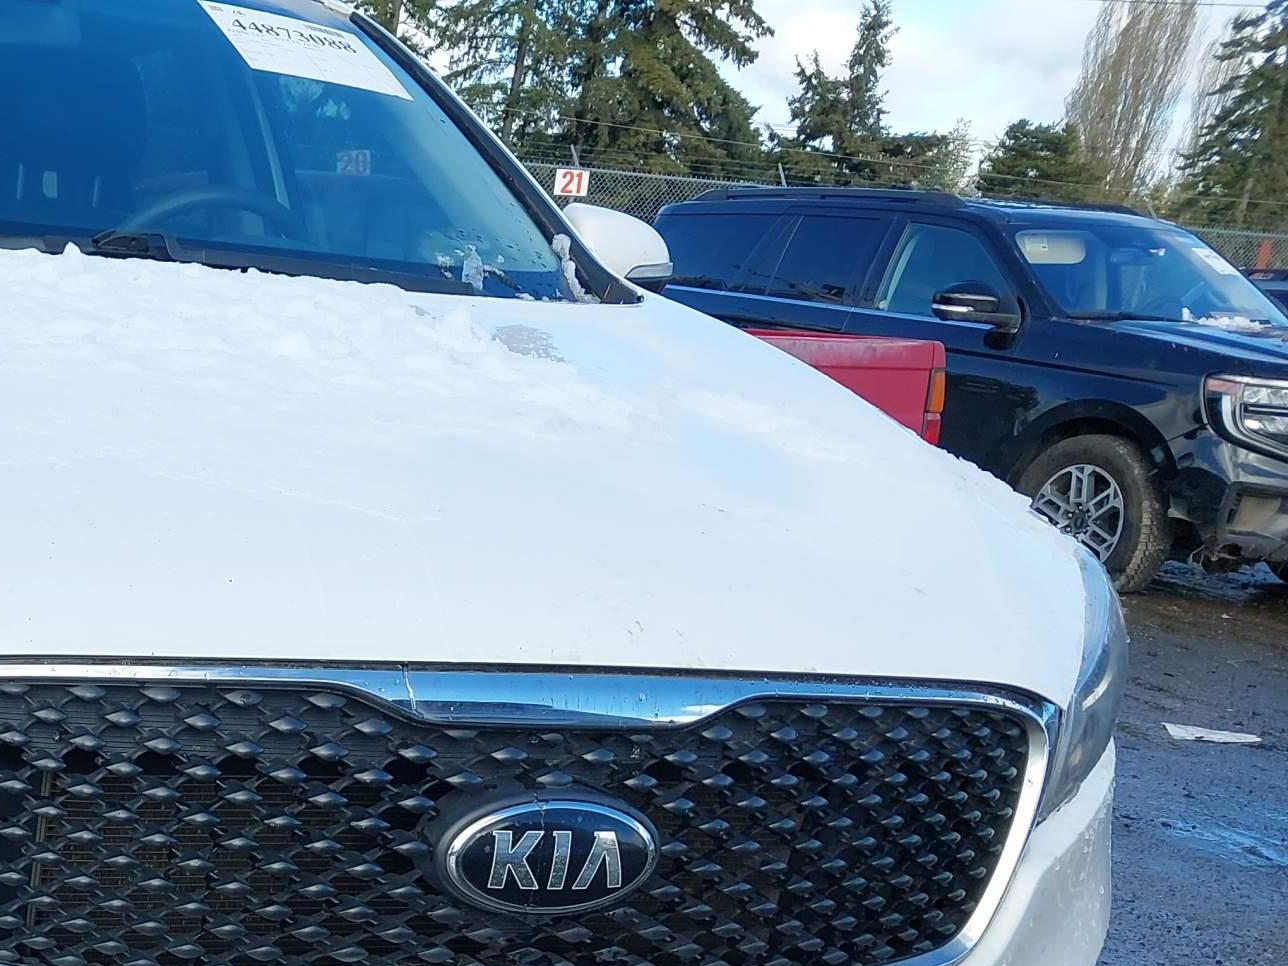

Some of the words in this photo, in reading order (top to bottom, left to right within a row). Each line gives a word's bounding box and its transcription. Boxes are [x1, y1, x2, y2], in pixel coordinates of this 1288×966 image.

[231, 18, 358, 54] 44873088
[560, 170, 584, 194] 21
[487, 830, 622, 891] KIA
